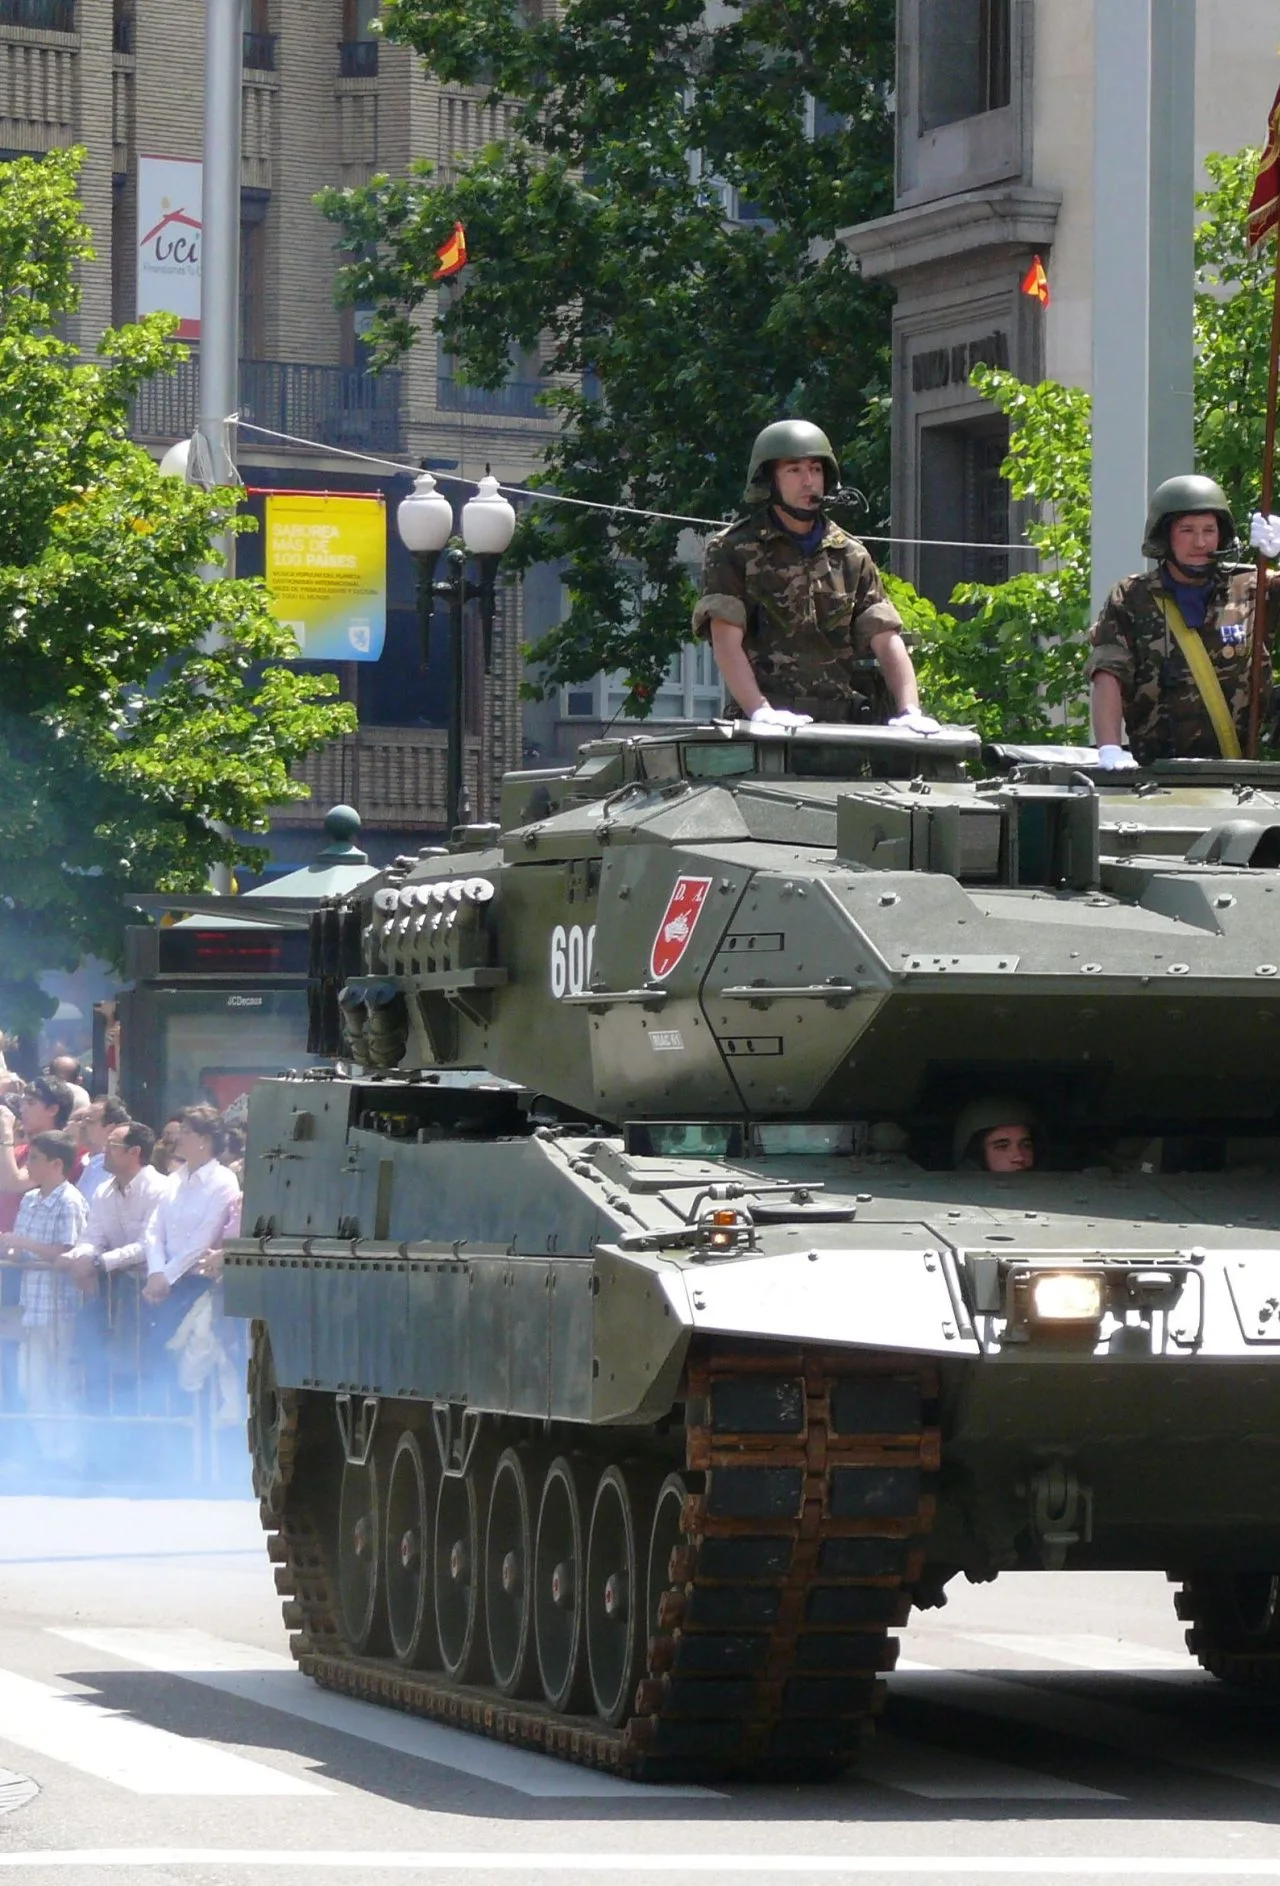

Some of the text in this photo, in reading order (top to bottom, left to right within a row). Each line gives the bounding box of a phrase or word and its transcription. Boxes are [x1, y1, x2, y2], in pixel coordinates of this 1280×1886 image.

[272, 523, 341, 538] SABOREA
[309, 540, 329, 553] DE
[274, 552, 302, 566] 100
